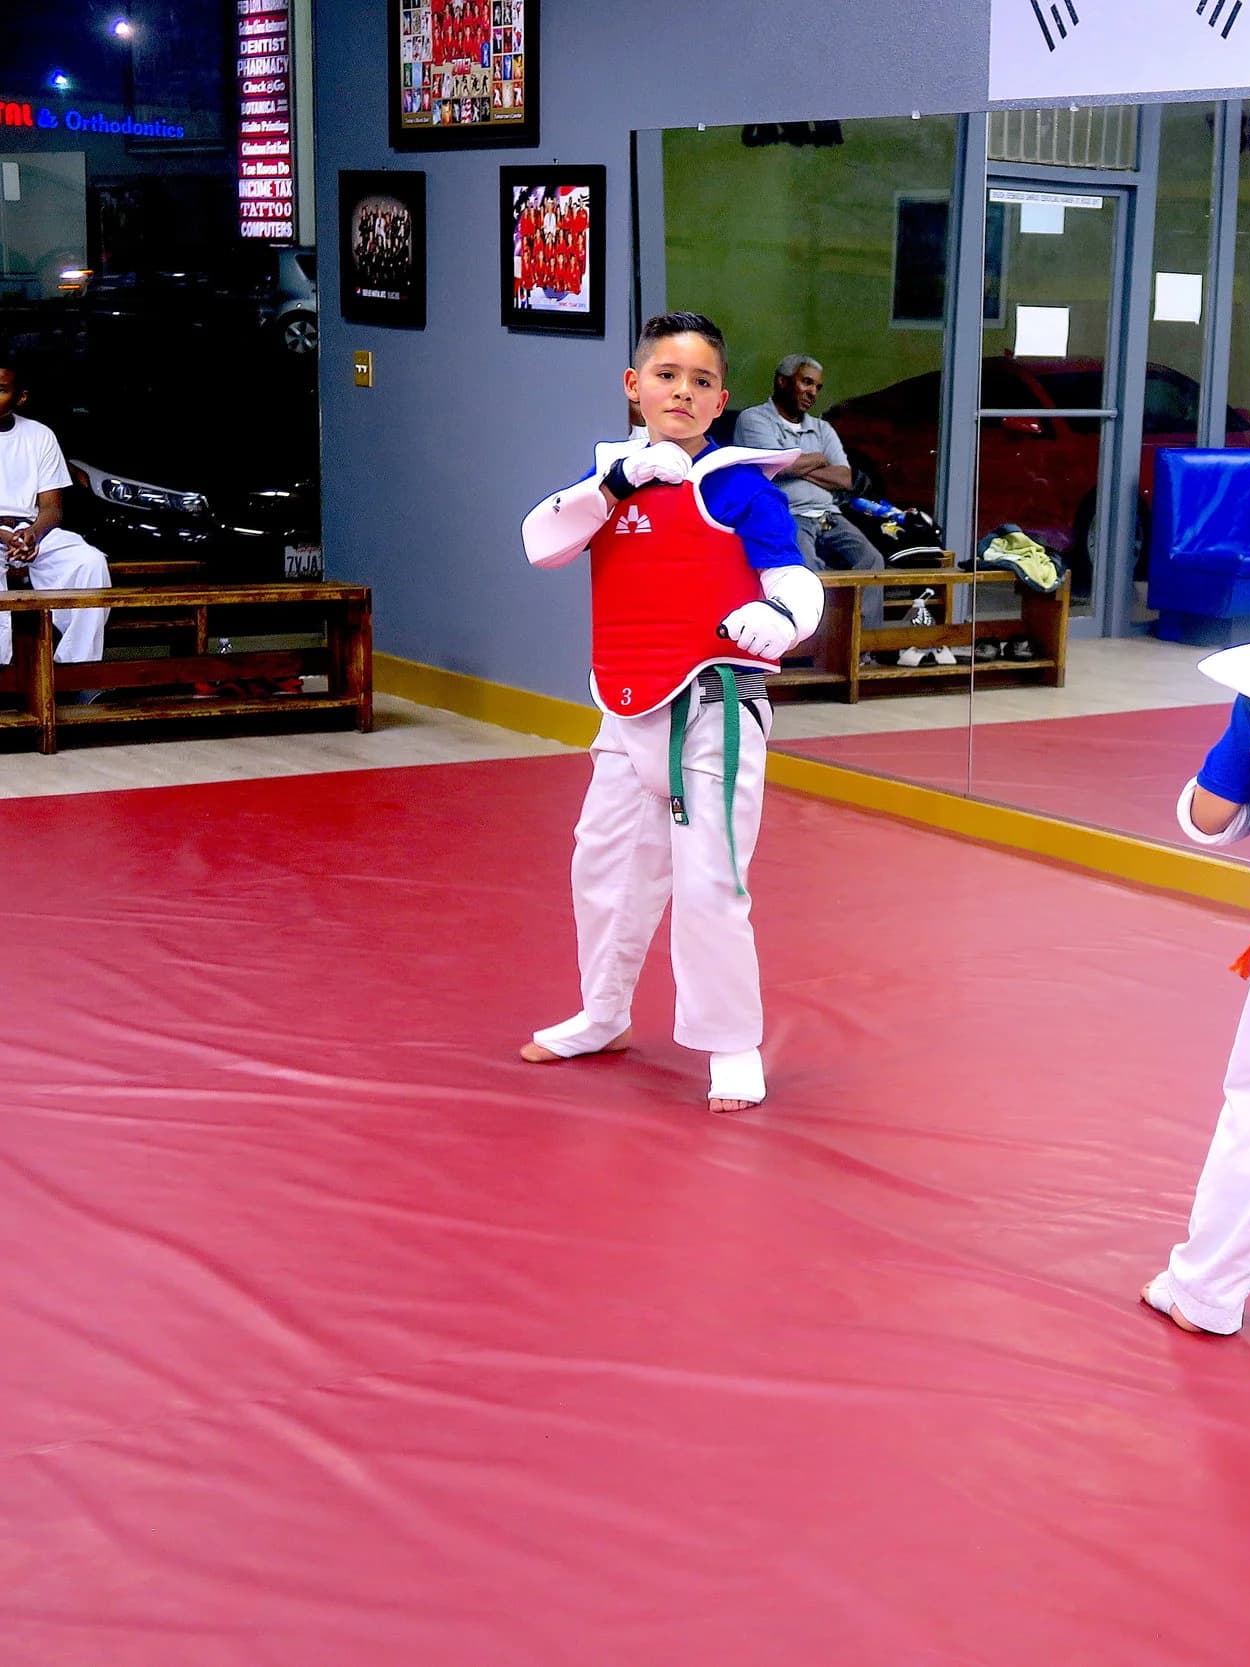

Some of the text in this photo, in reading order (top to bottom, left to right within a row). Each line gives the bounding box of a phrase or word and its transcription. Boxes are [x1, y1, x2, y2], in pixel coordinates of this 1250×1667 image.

[240, 37, 287, 55] DENTIST
[237, 56, 289, 77] PHARMACY
[37, 108, 59, 129] &
[65, 109, 184, 138] Orthodontics
[238, 179, 293, 198] INCOME TAX
[240, 202, 292, 217] TATTOO
[240, 221, 293, 238] COMPUTERS
[620, 687, 632, 706] 3
